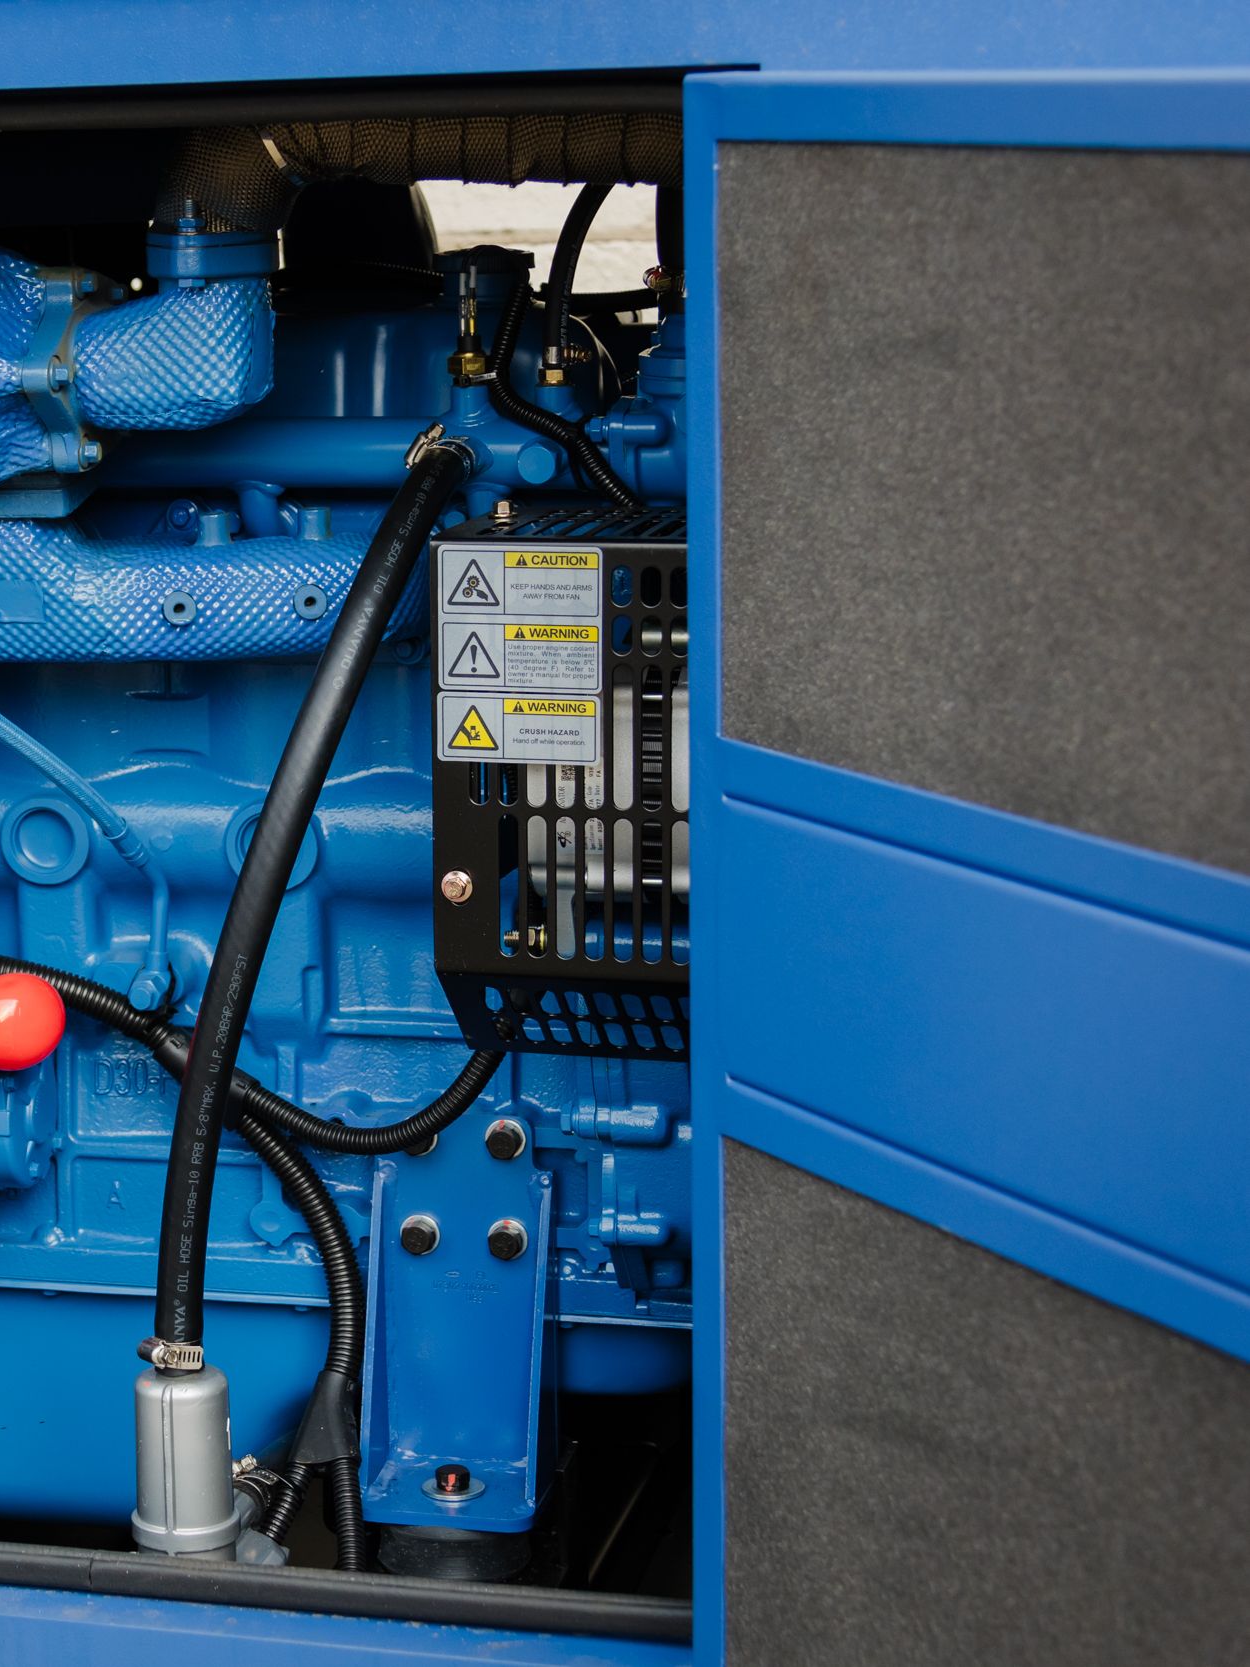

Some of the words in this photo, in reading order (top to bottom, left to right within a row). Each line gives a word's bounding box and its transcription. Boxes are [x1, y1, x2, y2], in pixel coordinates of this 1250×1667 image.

[373, 573, 391, 595] OIL
[384, 538, 404, 569] HOSE
[531, 555, 588, 566] CAUTION
[529, 628, 589, 639] WARNING
[527, 702, 587, 713] WARNING
[191, 1142, 205, 1165] RRB
[183, 1170, 200, 1228] Singa-10
[179, 1234, 193, 1264] HOSE
[177, 1270, 190, 1293] OIL
